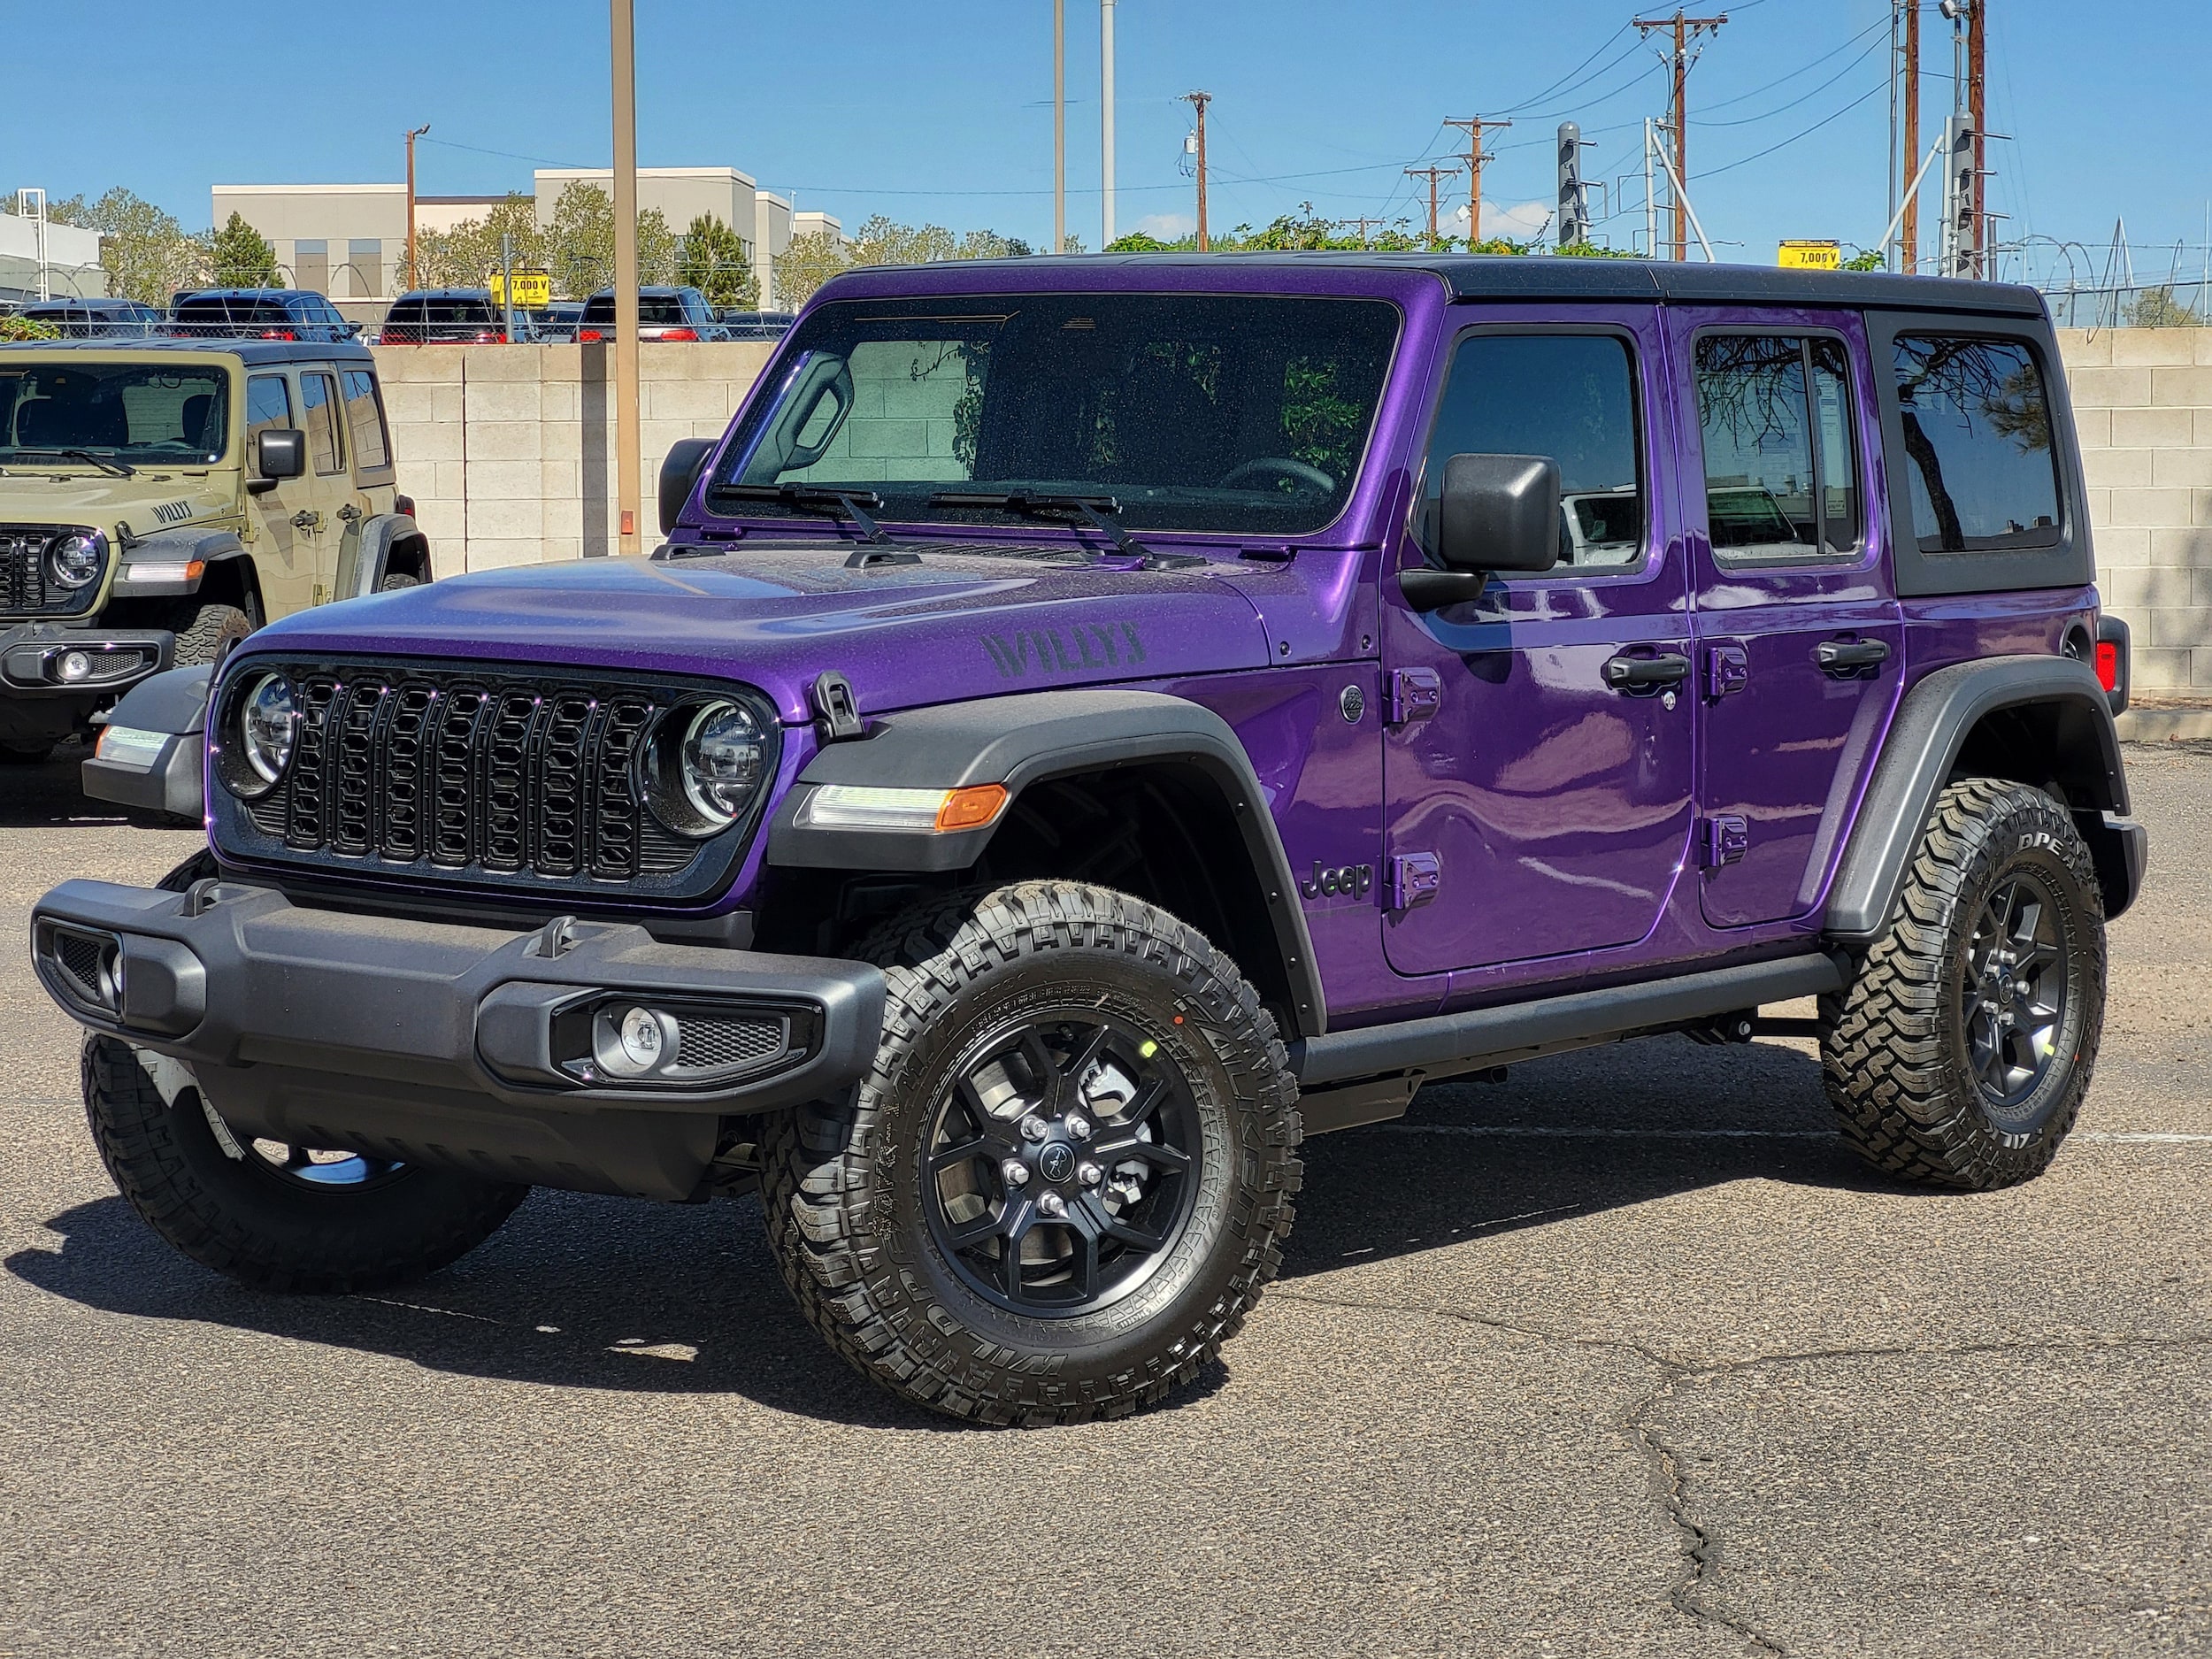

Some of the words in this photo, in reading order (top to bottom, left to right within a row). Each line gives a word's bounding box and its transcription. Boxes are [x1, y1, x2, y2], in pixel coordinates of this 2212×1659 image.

[1800, 252, 1828, 265] 7,000
[1830, 252, 1837, 263] V
[512, 280, 539, 291] 7,000
[541, 280, 548, 290] V
[150, 500, 193, 524] WILLYS
[978, 621, 1146, 678] WILLYS
[1301, 859, 1373, 901] Jeep
